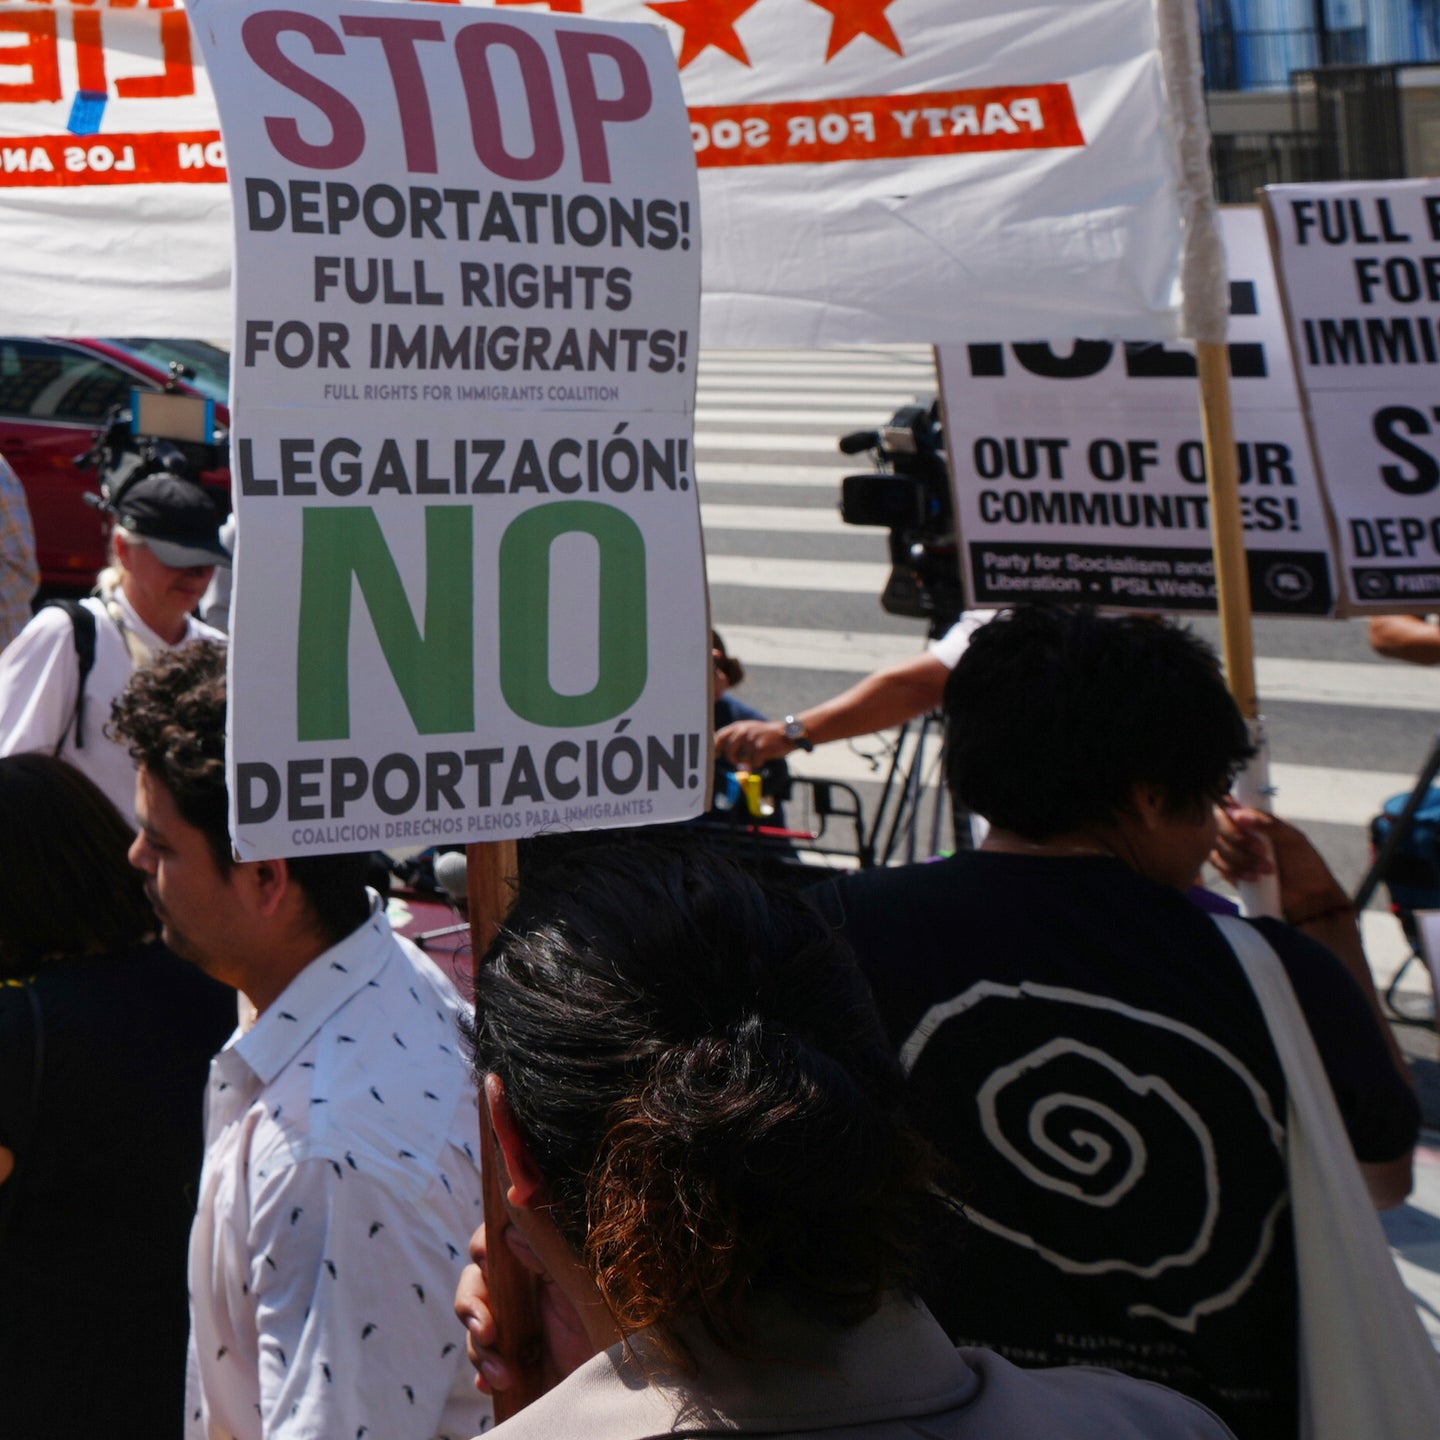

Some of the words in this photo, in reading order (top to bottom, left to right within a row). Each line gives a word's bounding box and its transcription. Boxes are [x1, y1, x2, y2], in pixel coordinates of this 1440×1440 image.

[241, 10, 652, 184] STOP
[245, 177, 690, 251] DEPORTATIONS!
[1291, 197, 1411, 245] FULL
[314, 256, 443, 306] FULL
[460, 261, 632, 311] RIGHTS
[244, 320, 350, 368] FOR
[370, 322, 687, 373] IMMIGRANTS!
[1302, 316, 1440, 366] IMMI
[323, 384, 360, 400] FULL
[363, 384, 419, 401] RIGHTS
[423, 385, 453, 401] FOR
[456, 384, 544, 401] IMMIGRANTS
[547, 384, 619, 401] COALITION
[239, 422, 689, 496] LEGALIZACIÓN!
[973, 437, 1069, 481] OUT
[1087, 439, 1160, 485] OF
[979, 489, 1302, 533] COMMUNITES!
[1033, 551, 1063, 570] for
[297, 500, 648, 742] NO
[237, 719, 700, 825] DEPORTACIÓN!
[292, 823, 380, 846] COALICION
[385, 816, 463, 838] DERECHOS
[467, 812, 521, 832] PLENOS
[525, 807, 561, 827] PARA
[565, 799, 653, 823] INMIGRANTES
